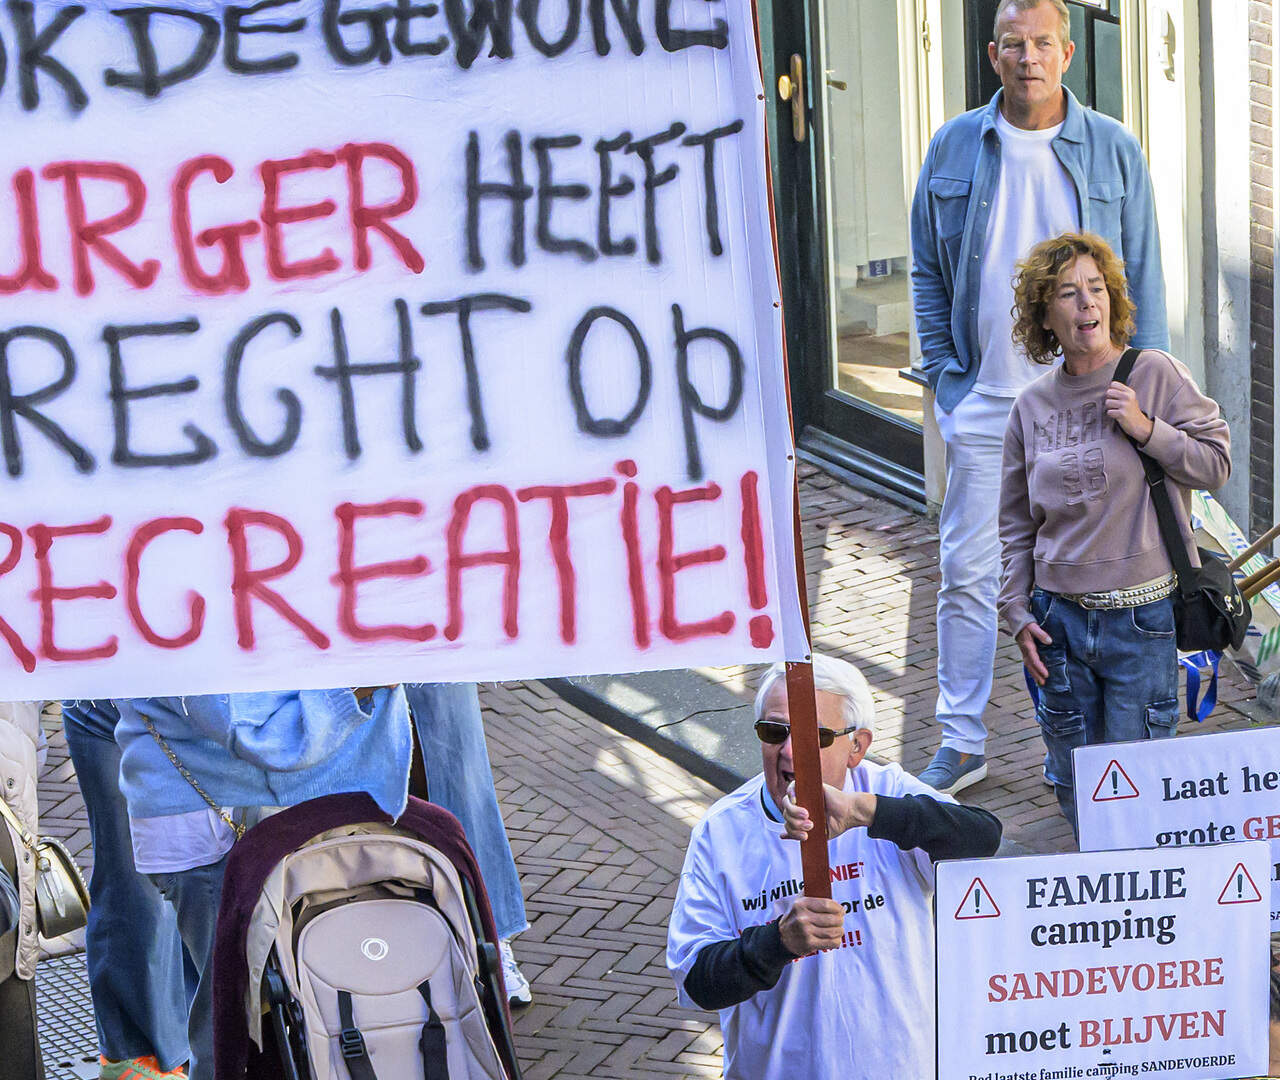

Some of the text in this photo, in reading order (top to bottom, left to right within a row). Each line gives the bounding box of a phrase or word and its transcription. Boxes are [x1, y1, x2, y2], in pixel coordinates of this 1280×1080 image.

[464, 119, 745, 272] HEEFT
[1162, 771, 1229, 802] Laat
[841, 894, 885, 914] or de
[1026, 867, 1187, 909] FAMILIE
[1031, 909, 1177, 948] camping
[988, 957, 1225, 1003] SANDEVOERE
[985, 1010, 1227, 1055] moet BLIJVEN
[1039, 1065, 1084, 1080] familie
[1086, 1062, 1140, 1080] camping
[1141, 1054, 1236, 1073] SANDEVOERDE
